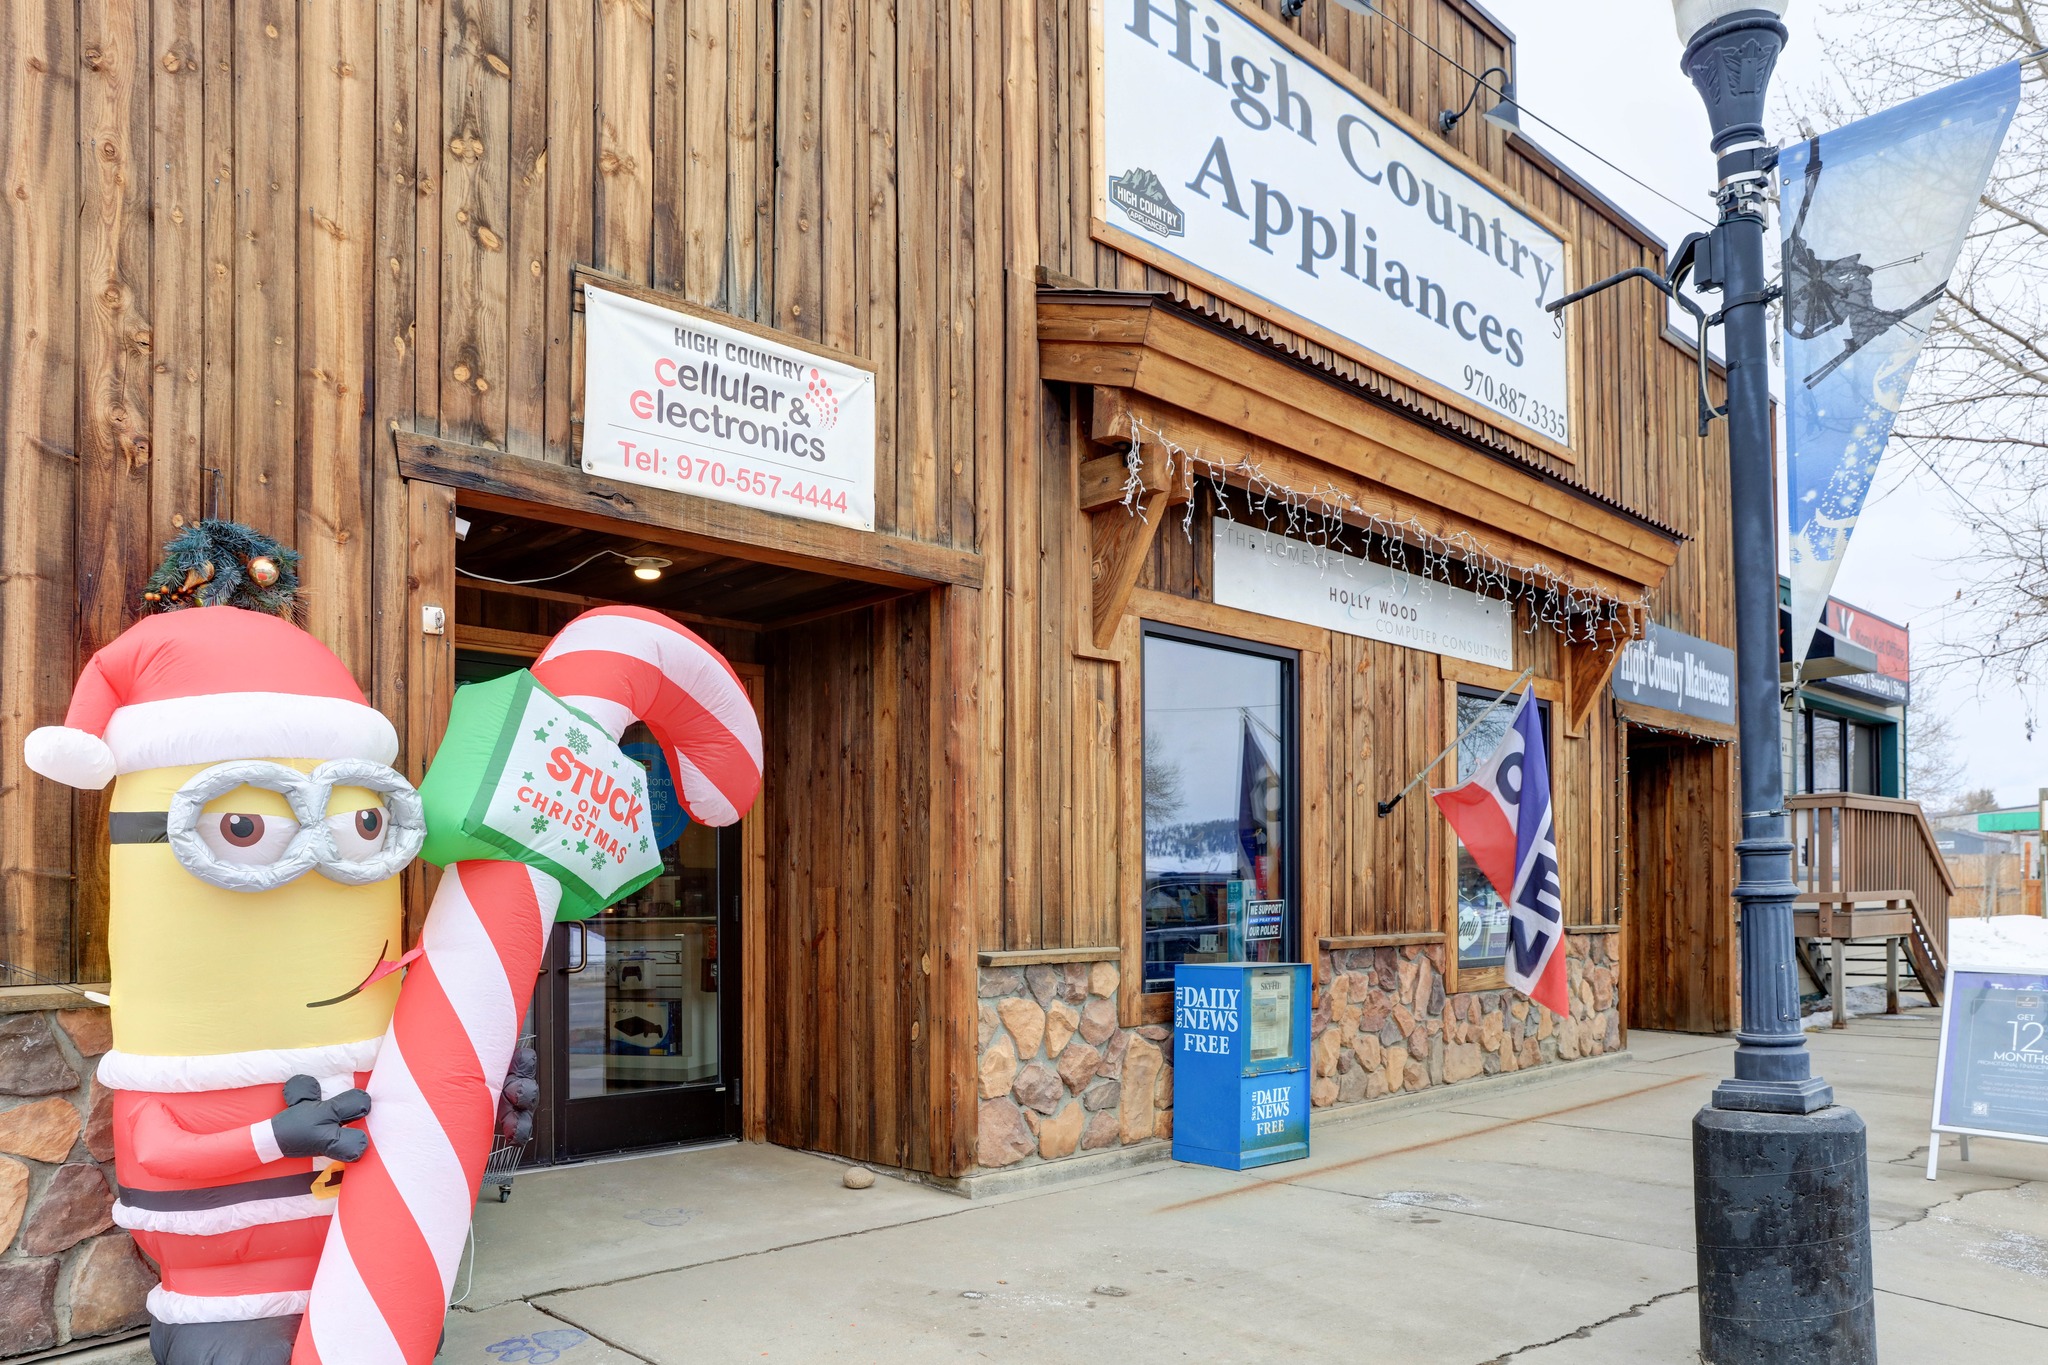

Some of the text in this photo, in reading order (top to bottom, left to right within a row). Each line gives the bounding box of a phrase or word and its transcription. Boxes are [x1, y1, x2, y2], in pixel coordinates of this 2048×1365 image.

[1124, 0, 1555, 308] High Country
[1117, 186, 1177, 228] HIGH COUNTRY
[1130, 211, 1167, 234] APPLIANCES
[1184, 136, 1524, 368] Appliances
[674, 327, 804, 382] HIGH COUNTRY
[788, 397, 811, 428] &
[1463, 363, 1566, 439] 970.887.3335
[617, 440, 848, 514] Tel: 970-557-4444
[1227, 528, 1256, 549] THE
[1264, 540, 1309, 566] HOME
[1329, 586, 1417, 622] HOLLY WOOD
[1376, 619, 1509, 662] COMPUTER CONSULTING
[1621, 640, 1730, 708] High Country Mattresses
[545, 745, 644, 833] STUCK
[517, 786, 628, 864] CHRISTMAS
[578, 799, 600, 819] ON
[1250, 904, 1282, 915] WE SUPPORT
[1249, 924, 1279, 936] OUR POLICE
[1184, 986, 1241, 1010] DAILY
[1183, 1007, 1239, 1033] NEWS
[2016, 1013, 2036, 1021] GET
[1184, 1033, 1230, 1055] FREE
[2006, 1020, 2045, 1053] 12
[1256, 1086, 1290, 1105] DAILY
[1256, 1102, 1290, 1120] NEWS
[1256, 1119, 1285, 1136] FREE
